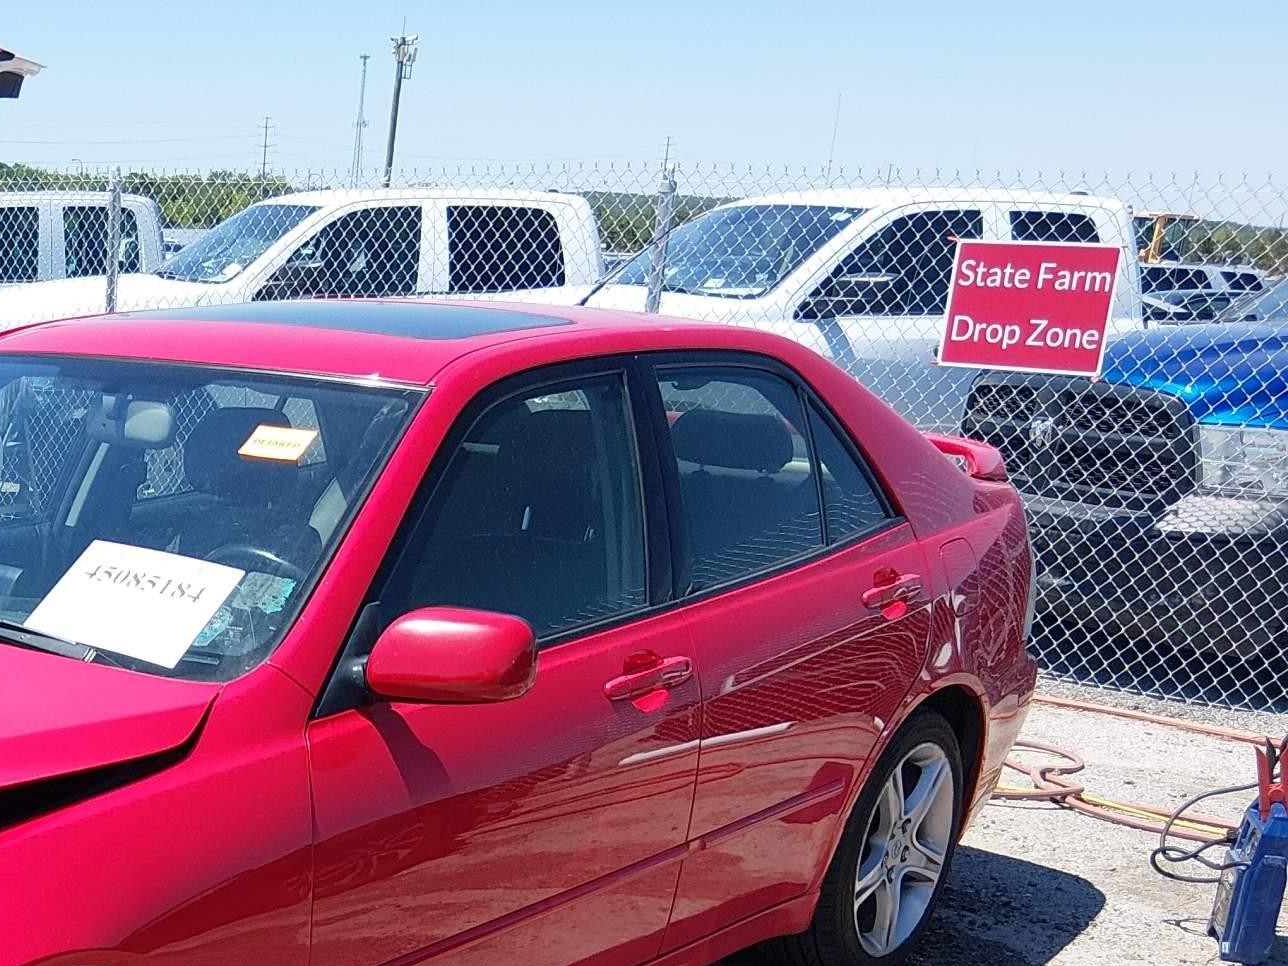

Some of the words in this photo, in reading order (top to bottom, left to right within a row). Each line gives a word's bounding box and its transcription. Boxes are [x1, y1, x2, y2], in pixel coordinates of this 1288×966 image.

[958, 259, 1031, 289] State
[1037, 262, 1111, 292] Farm
[950, 315, 1021, 350] Drop
[1025, 319, 1099, 350] Zone
[85, 565, 207, 603] 45085184
